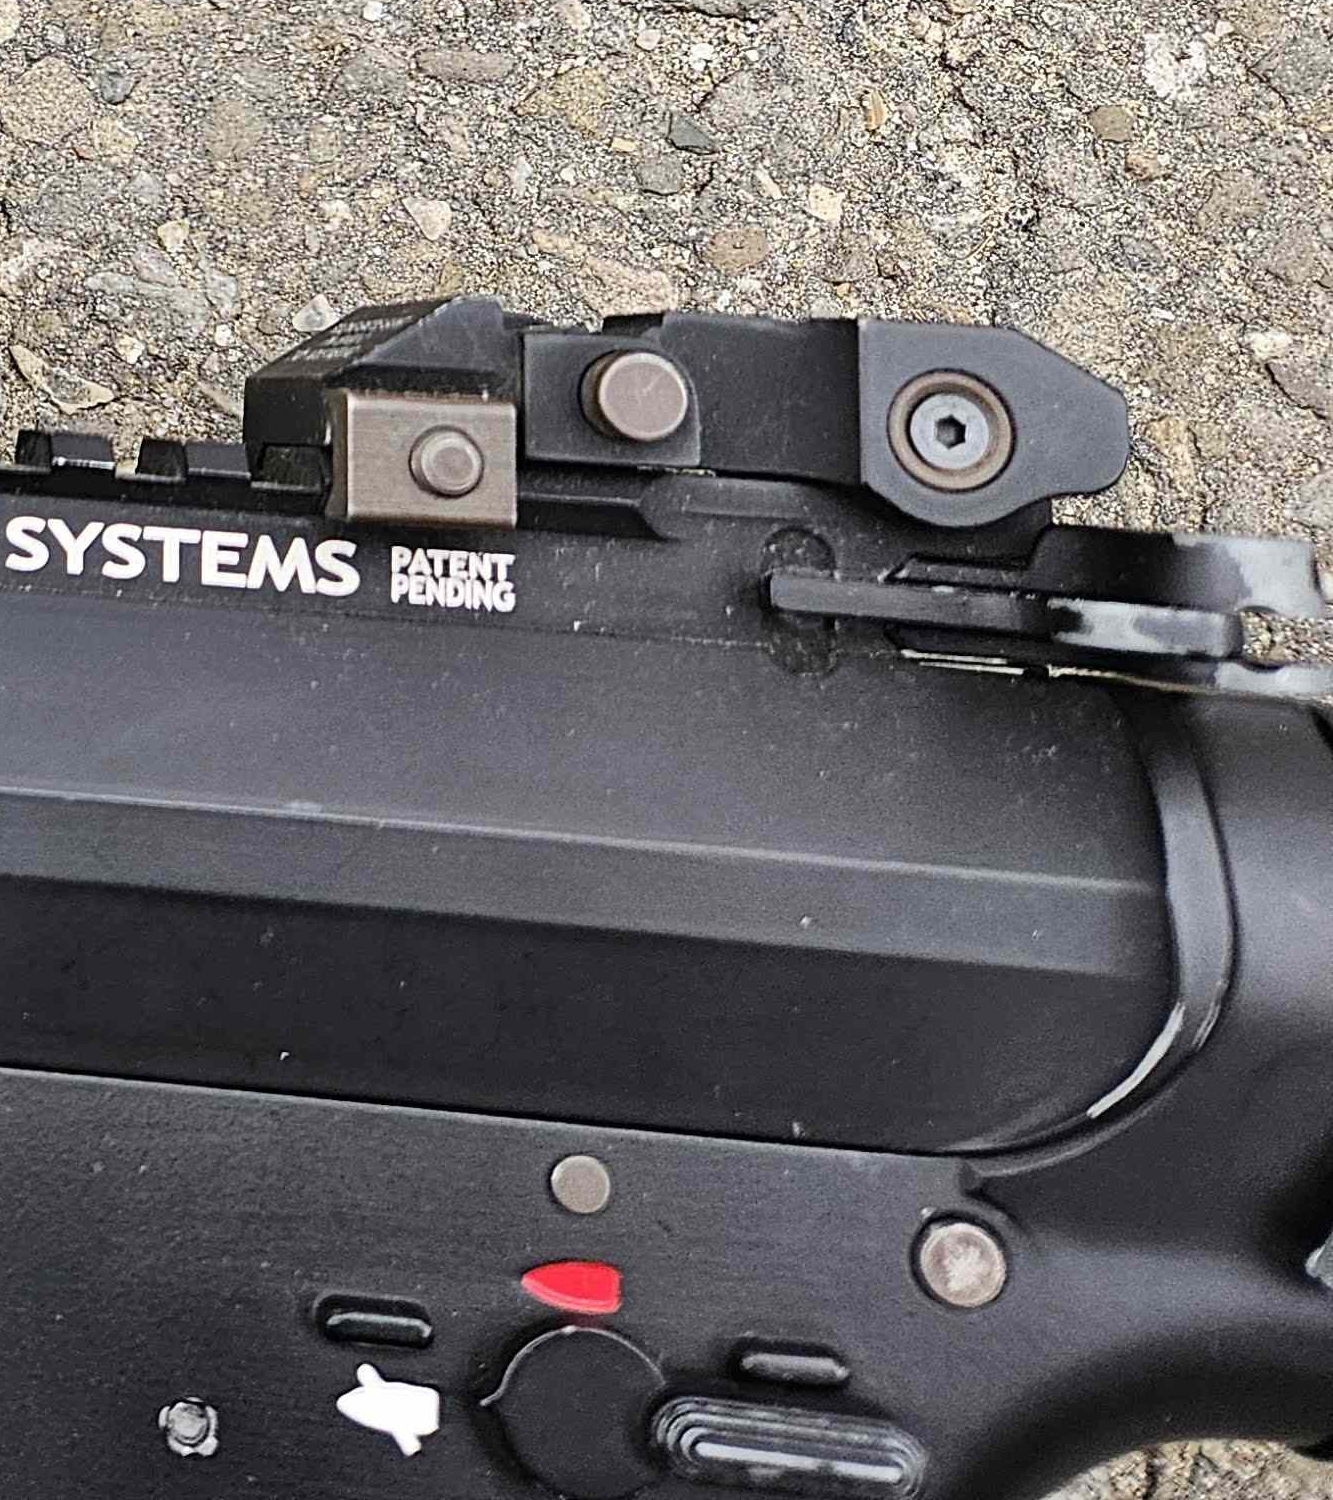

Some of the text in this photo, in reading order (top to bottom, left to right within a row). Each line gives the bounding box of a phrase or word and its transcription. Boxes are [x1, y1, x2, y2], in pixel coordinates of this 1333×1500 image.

[5, 515, 361, 597] SYSTEMS
[391, 545, 516, 582] PATENT
[390, 571, 516, 613] PENDING
